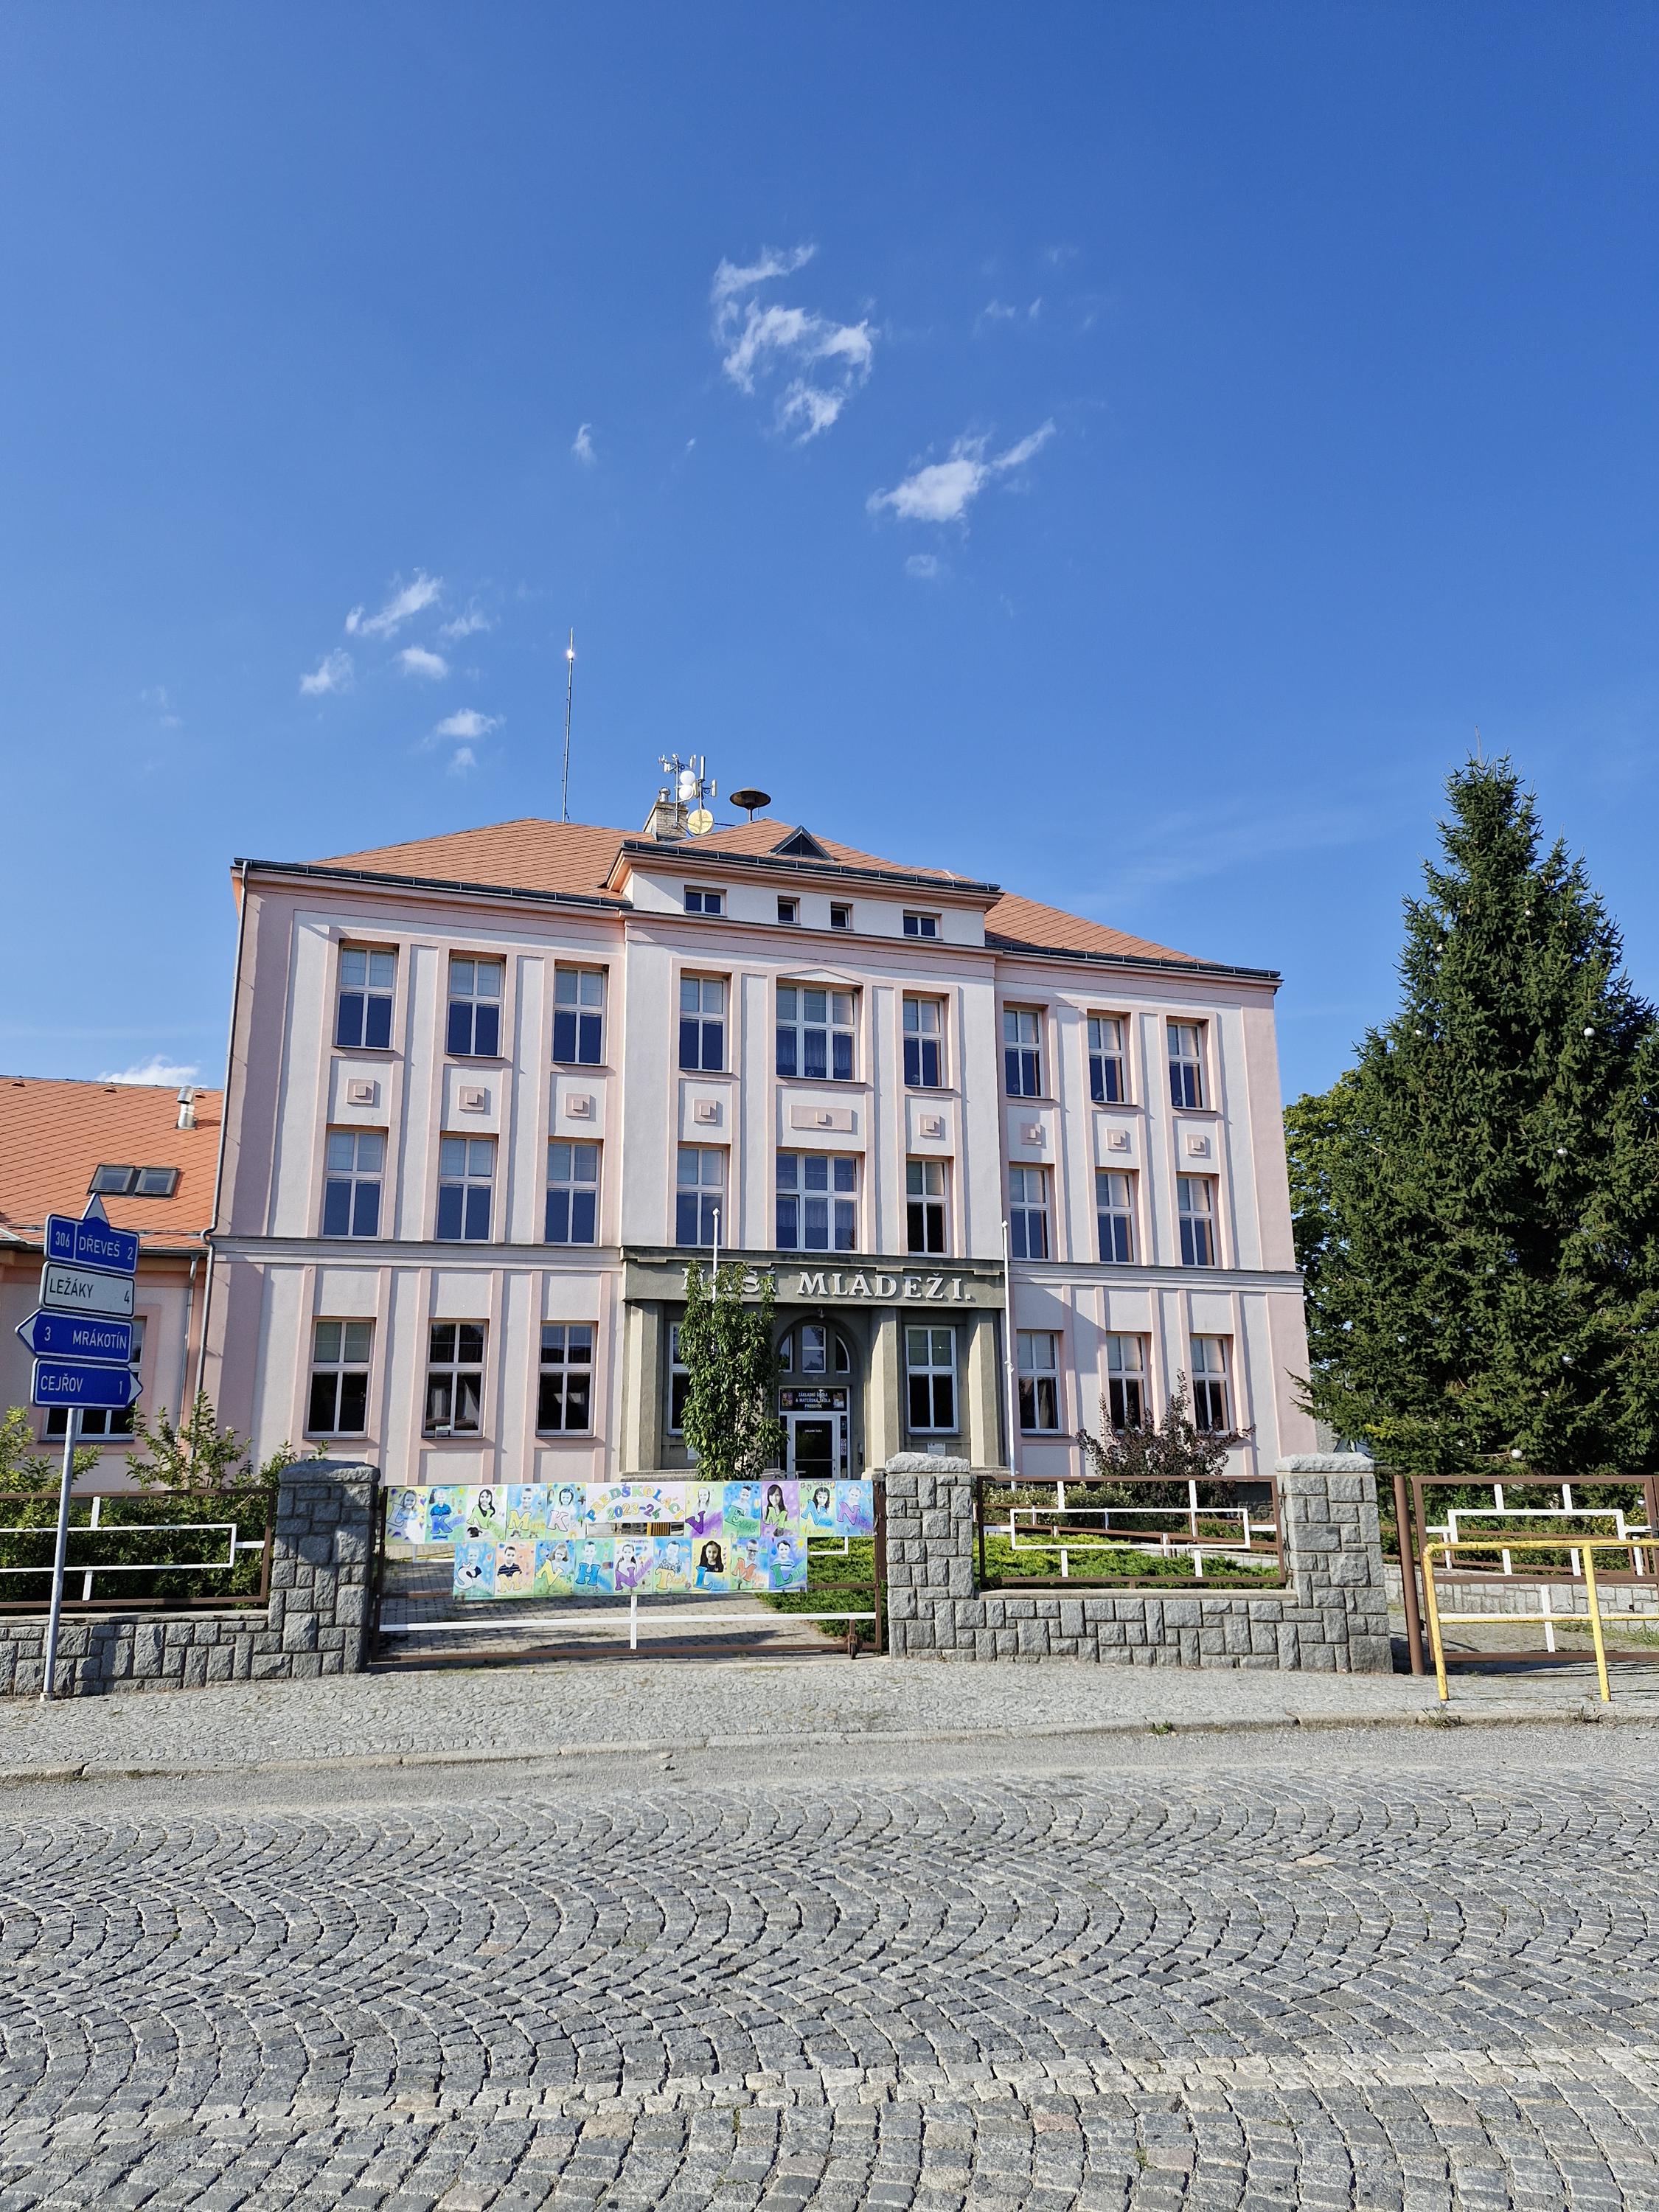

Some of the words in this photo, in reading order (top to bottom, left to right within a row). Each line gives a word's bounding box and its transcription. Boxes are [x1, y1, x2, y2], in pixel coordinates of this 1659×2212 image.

[55, 1231, 70, 1248] 306
[78, 1234, 120, 1257] DŘEVEŠ
[127, 1246, 133, 1260] 2
[49, 1276, 94, 1298] LEŽÁKY
[123, 1290, 130, 1304] 4
[796, 1269, 971, 1301] MLÁDEŽI.
[44, 1326, 52, 1341] 3
[72, 1329, 127, 1349] MRÁKOTÍN
[41, 1373, 84, 1393] CEJŘOV
[119, 1380, 123, 1396] 1
[606, 1502, 661, 1520] 2023-24
